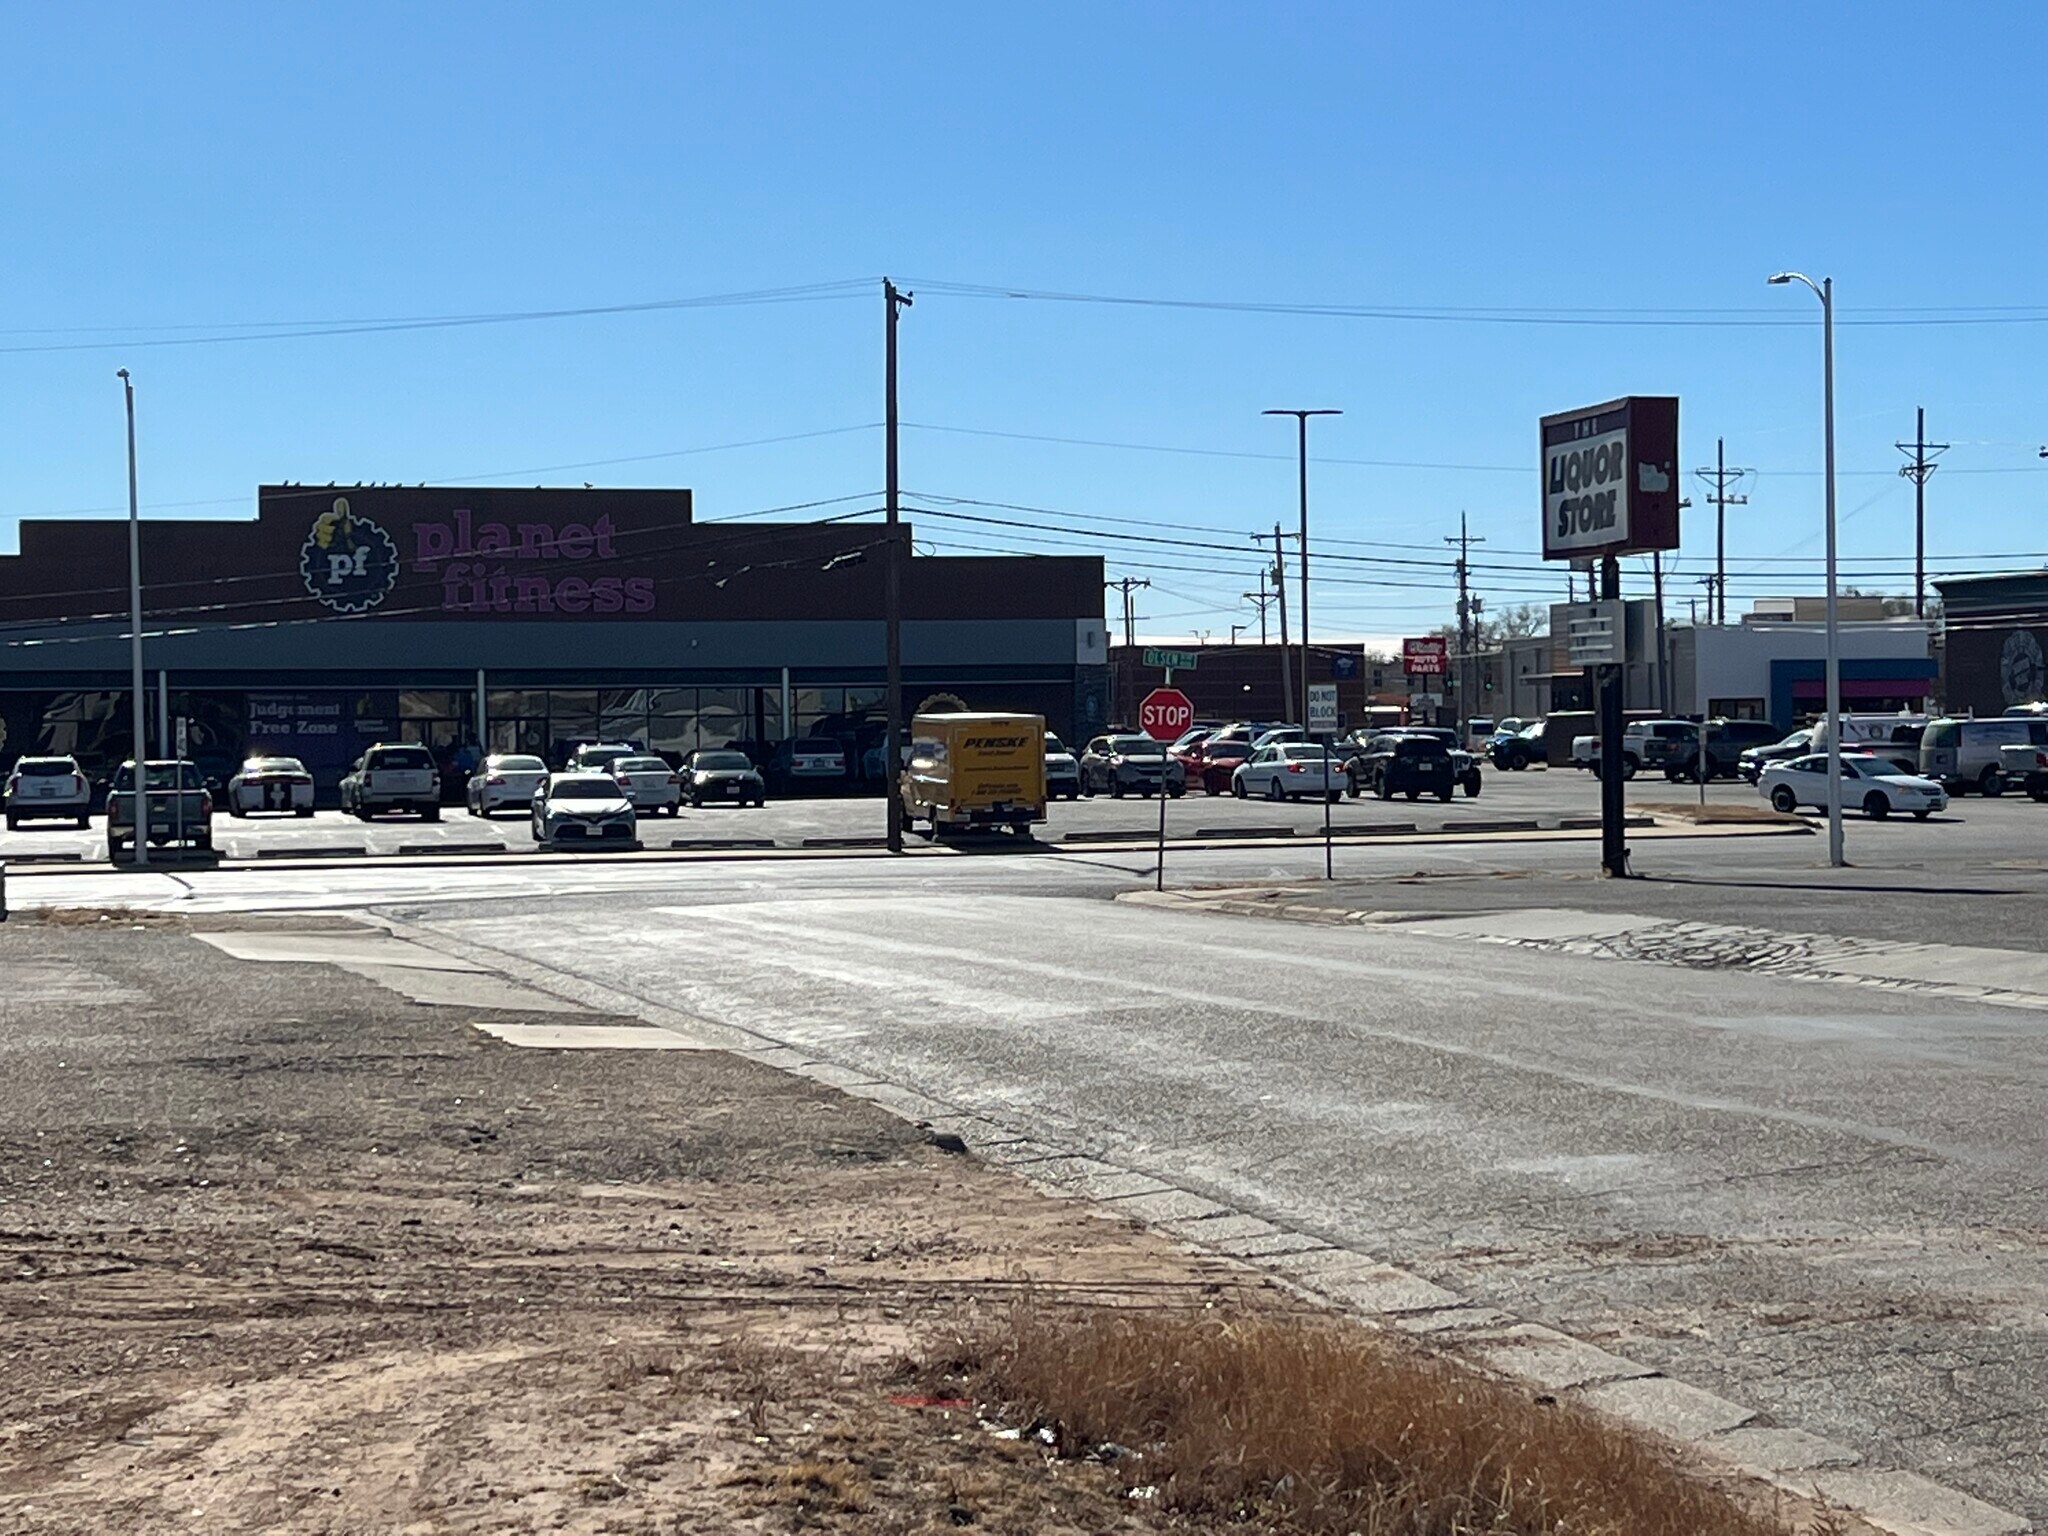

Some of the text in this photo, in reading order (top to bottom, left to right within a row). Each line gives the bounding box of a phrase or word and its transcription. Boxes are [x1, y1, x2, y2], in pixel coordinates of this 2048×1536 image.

[1549, 441, 1624, 495] LIQUOR
[1558, 489, 1617, 538] STORE
[412, 508, 618, 573] planet
[327, 546, 372, 584] pf
[440, 563, 656, 613] fitness
[1147, 651, 1179, 665] OLSEN
[1411, 664, 1441, 673] PARTS
[1310, 690, 1336, 702] DO NOT
[1143, 705, 1189, 727] STOP
[1310, 706, 1336, 718] BLOCK
[249, 721, 338, 735] Free Zone
[963, 737, 1029, 748] PENSKE
